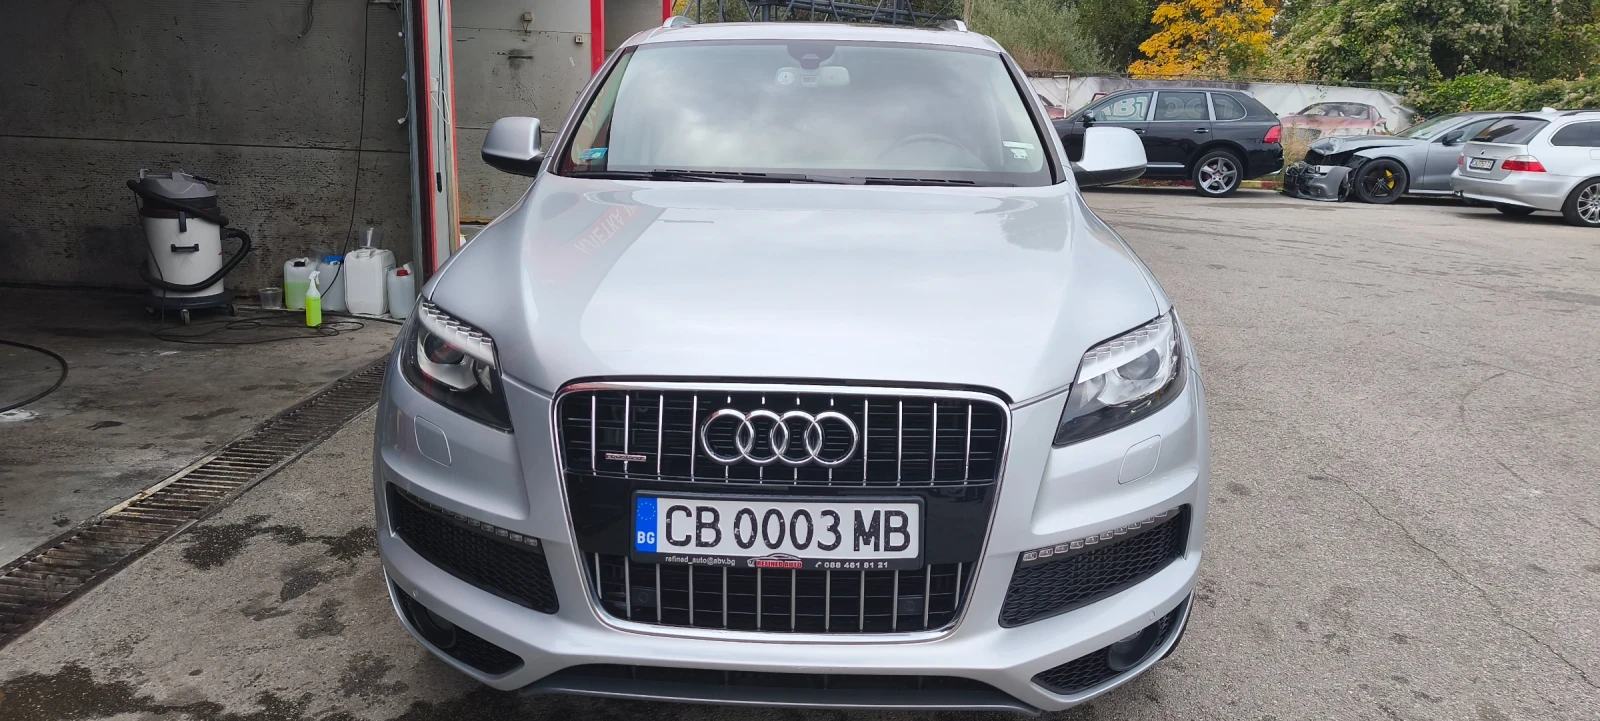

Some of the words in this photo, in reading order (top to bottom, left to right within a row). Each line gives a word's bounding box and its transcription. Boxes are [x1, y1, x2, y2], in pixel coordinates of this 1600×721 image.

[665, 504, 722, 548] CB
[733, 507, 842, 552] 0003
[853, 509, 911, 552] MB
[637, 531, 655, 544] BG
[877, 561, 888, 569] 21
